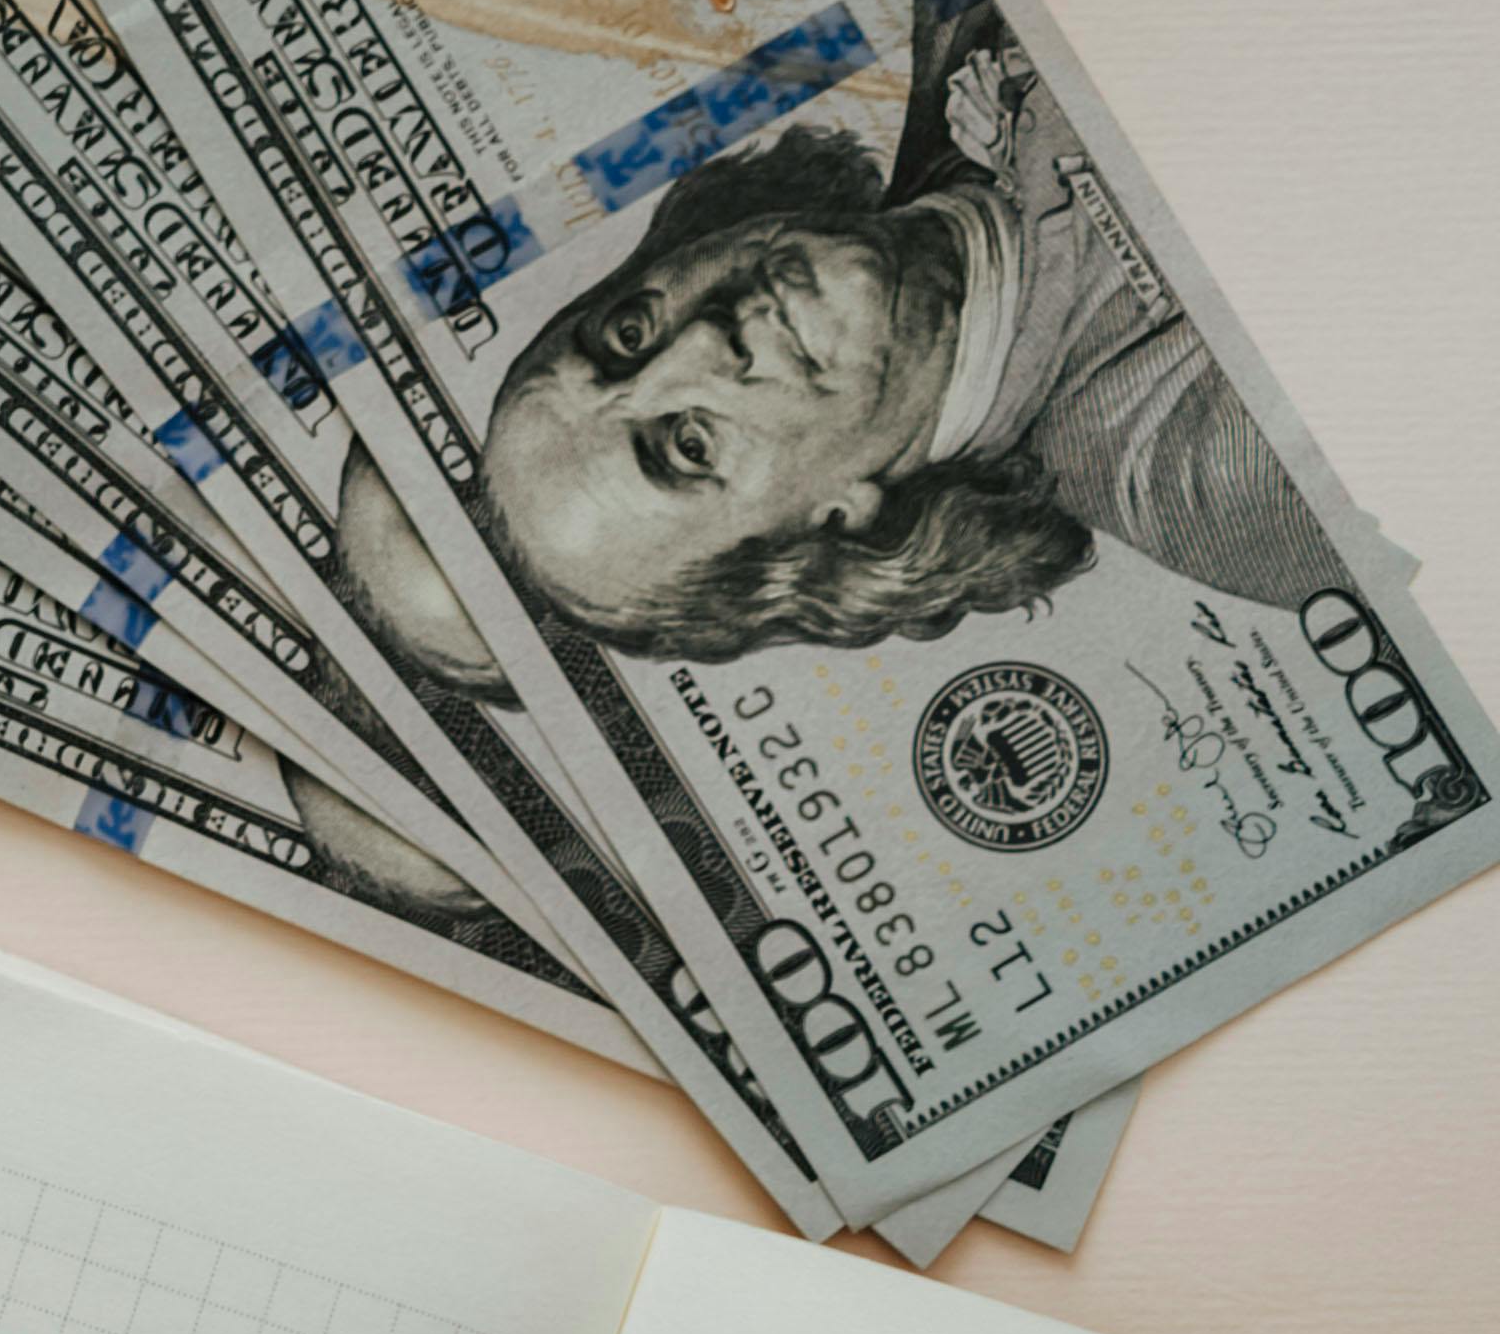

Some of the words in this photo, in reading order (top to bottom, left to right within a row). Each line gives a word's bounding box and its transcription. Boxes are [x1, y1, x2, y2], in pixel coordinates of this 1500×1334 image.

[258, 147, 413, 380] HUNDRED
[332, 106, 499, 360] UNITED
[430, 178, 516, 285] OF
[1077, 180, 1156, 294] FRANKLIN
[403, 382, 473, 482] ONE
[669, 667, 739, 762] NOTE
[731, 682, 773, 718] C
[1297, 586, 1455, 795] 100
[734, 760, 839, 922] RESERVE
[755, 728, 935, 979] 83801932
[832, 919, 936, 1077] FEDERAL
[920, 979, 980, 1052] ML
[968, 907, 1054, 1014] L12
